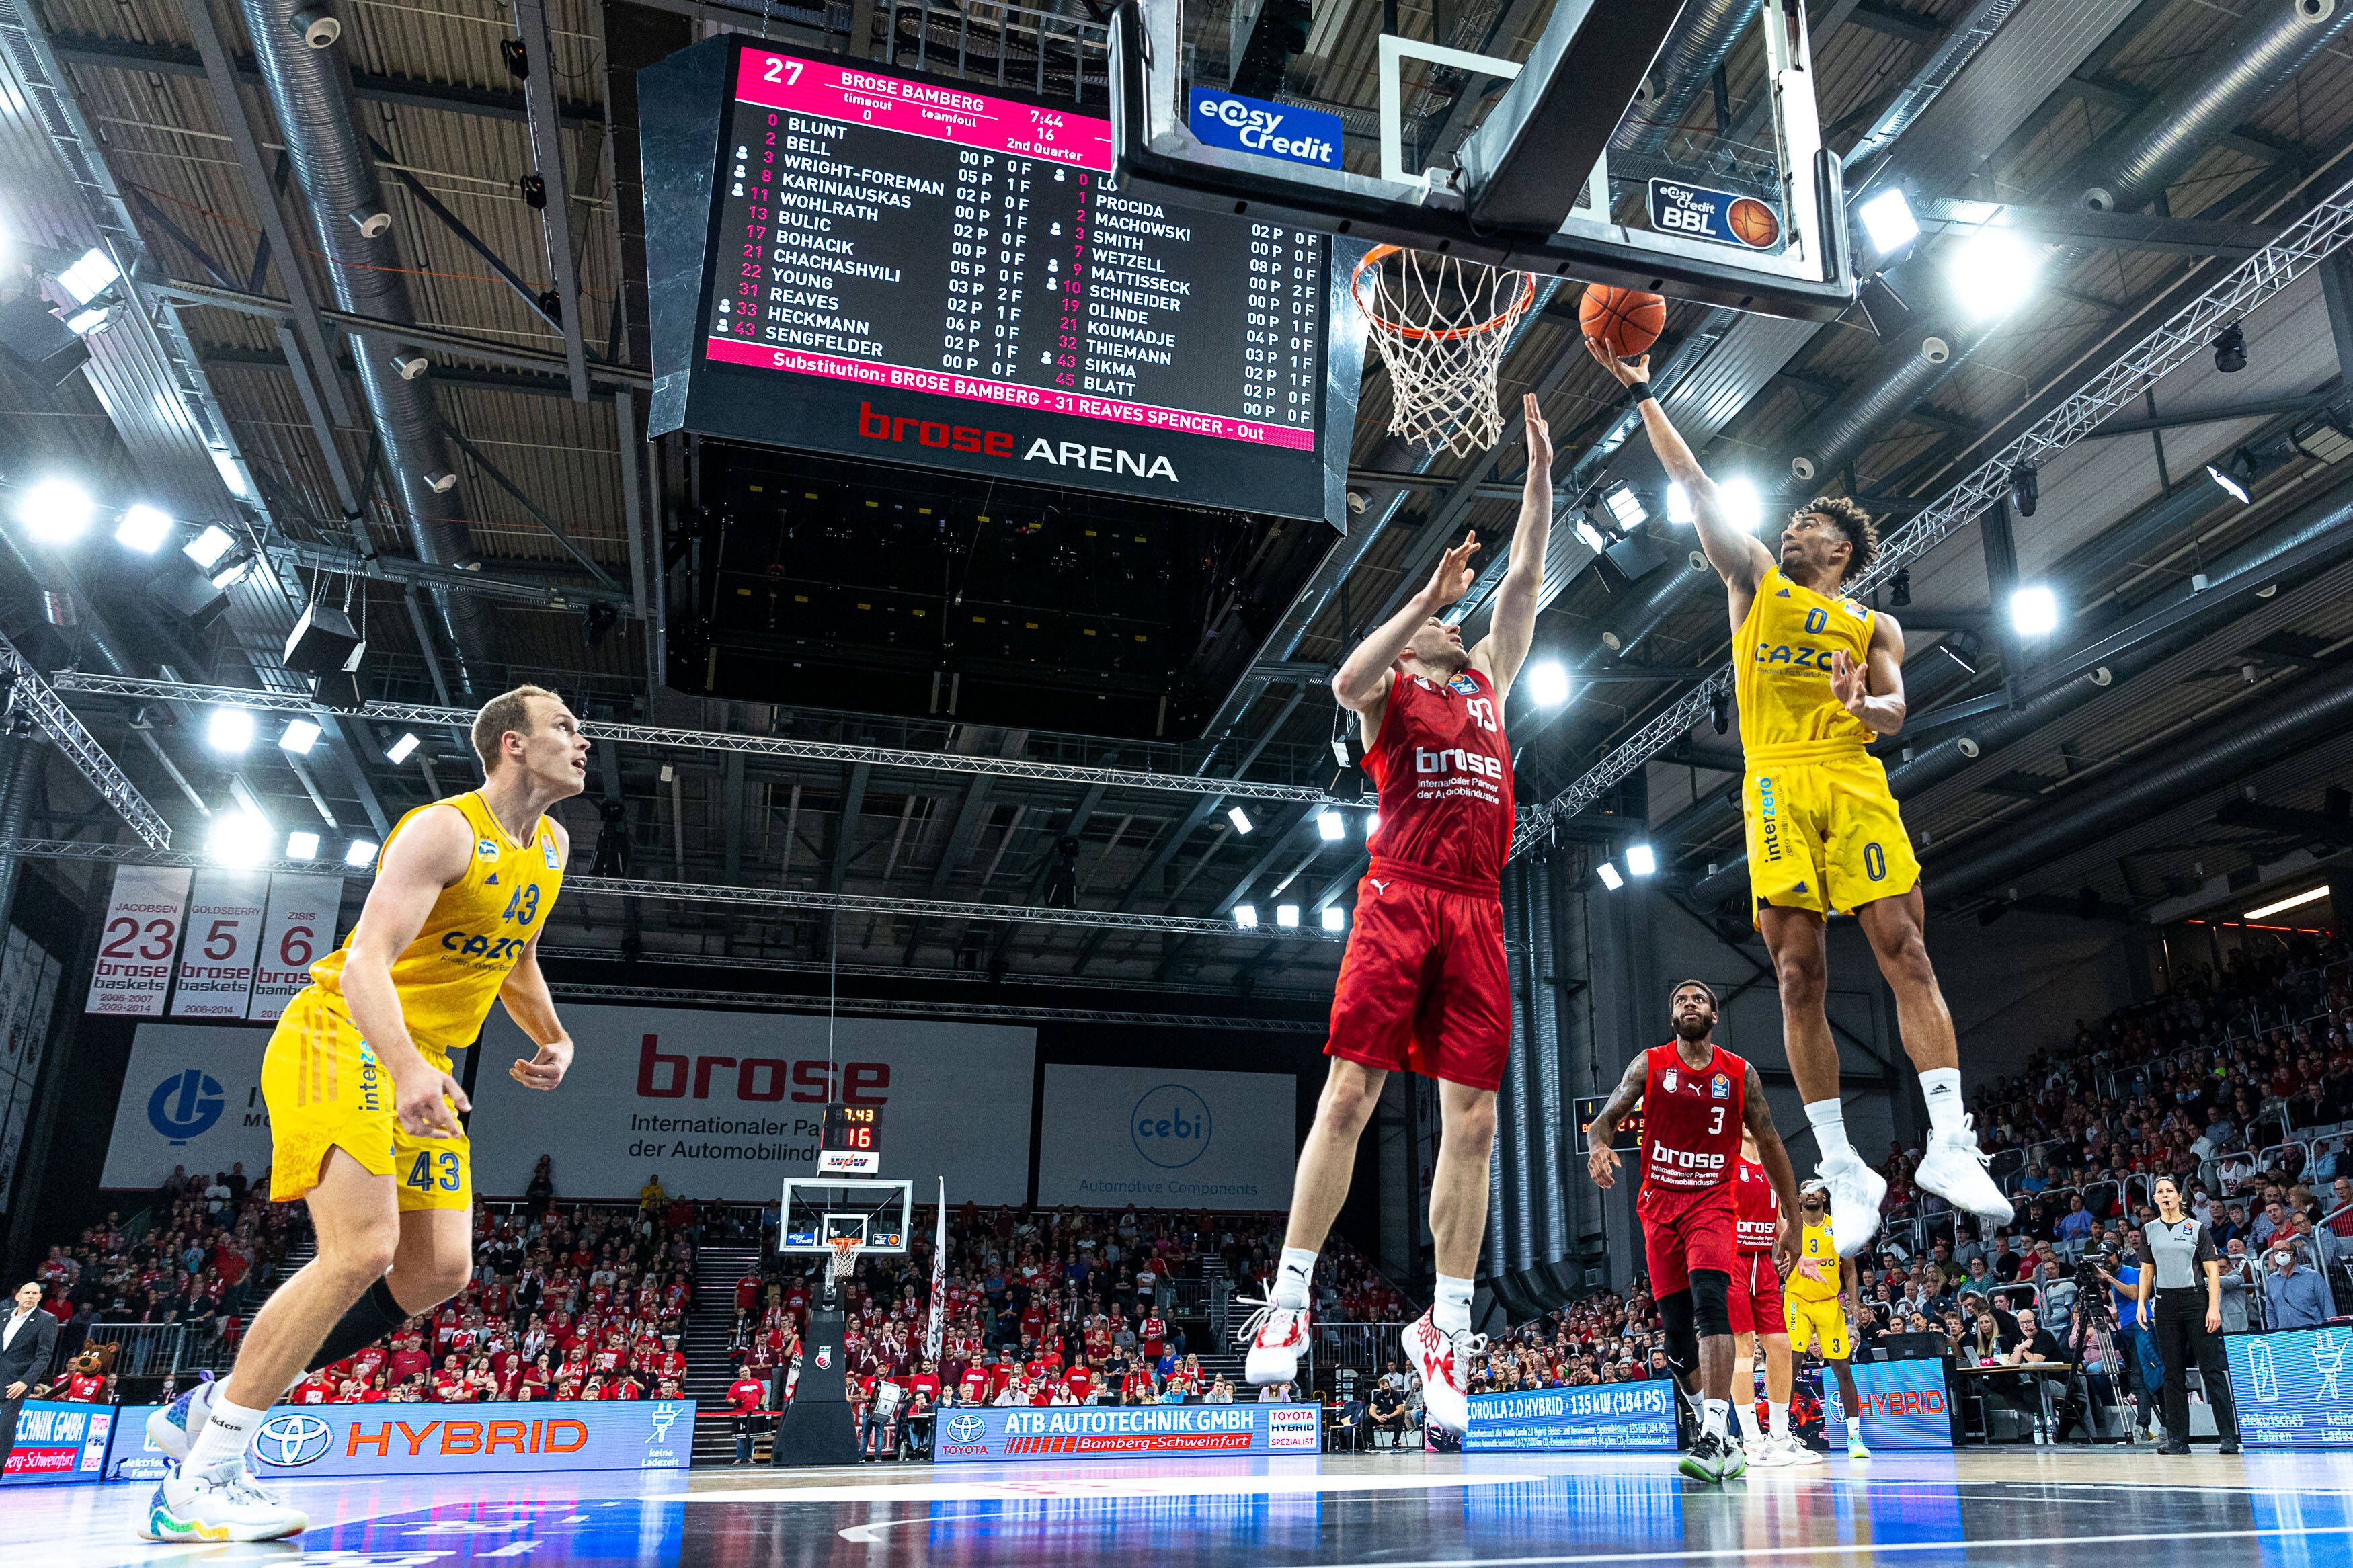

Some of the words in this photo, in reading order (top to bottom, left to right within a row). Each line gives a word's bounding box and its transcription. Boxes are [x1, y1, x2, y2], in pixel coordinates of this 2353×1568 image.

[763, 57, 804, 86] 27
[841, 71, 898, 95] BROSE
[902, 84, 984, 112] BAMBERG
[844, 92, 893, 111] timeout
[767, 113, 779, 127] 0
[788, 116, 848, 140] BLUNT
[863, 109, 872, 120] 0
[921, 108, 977, 128] teamfoul
[1030, 110, 1064, 128] 7:44
[765, 131, 776, 146] 2
[786, 135, 831, 157] BELL
[945, 125, 951, 137] 1
[1037, 127, 1055, 141] 16
[1239, 125, 1333, 163] Credit
[1006, 137, 1031, 151] 2nd
[1033, 142, 1084, 161] Quarter
[763, 150, 774, 164] 3
[784, 153, 945, 196] WRIGHT-FOREMAN
[1078, 173, 1088, 186] 0
[1097, 176, 1117, 192] LO
[761, 169, 772, 183] 8
[782, 172, 912, 208] KARINIAUSKAS
[750, 186, 768, 202] 11
[780, 191, 879, 222] WOHLRATH
[1078, 191, 1086, 204] 1
[1096, 194, 1164, 219] PROCIDA
[1677, 198, 1715, 214] Credit
[749, 205, 768, 221] 13
[778, 210, 832, 232] BULIC
[1076, 209, 1086, 222] 2
[1095, 212, 1191, 242] MACHOWSKI
[1662, 206, 1716, 235] BBL
[747, 224, 766, 239] 17
[776, 229, 854, 255] BOHACIK
[1075, 226, 1084, 240] 3
[1092, 230, 1144, 251] SMITH
[743, 243, 762, 259] 21
[774, 249, 901, 282] CHACHASHVILI
[1074, 244, 1084, 257] 7
[1092, 247, 1166, 274] WETZELL
[742, 263, 762, 279] 22
[772, 267, 833, 290] YOUNG
[1073, 263, 1082, 276] 9
[1091, 265, 1191, 296] MATTISSECK
[738, 282, 758, 297] 31
[770, 286, 839, 311] REAVES
[1063, 280, 1082, 294] 10
[1089, 284, 1181, 312] SCHNEIDER
[736, 300, 758, 317] 33
[768, 306, 869, 335] HECKMANN
[1062, 298, 1080, 313] 19
[1088, 302, 1148, 325] OLINDE
[733, 321, 756, 337] 43
[765, 325, 883, 357] SENGFELDER
[1059, 316, 1077, 331] 21
[1088, 321, 1176, 347] KOUMADJE
[1059, 335, 1077, 350] 32
[1086, 339, 1172, 366] THIEMANN
[1056, 353, 1076, 368] 43
[1084, 358, 1137, 378] SIKMA
[772, 352, 885, 381] Substitution:
[890, 370, 950, 392] BROSE
[954, 380, 1039, 405] BAMBERG
[1055, 395, 1073, 411] 31
[1078, 399, 1144, 421] REAVES
[1146, 410, 1222, 434] SPENCER
[1238, 424, 1264, 440] Out
[1055, 372, 1075, 386] 45
[1084, 376, 1136, 397] BLATT
[858, 401, 1014, 458] brose
[1023, 438, 1179, 482] ARENA
[1804, 608, 1827, 634] 0
[1755, 643, 1845, 675] CAZO
[1466, 698, 1497, 732] 43
[1416, 746, 1502, 780] brose
[1417, 790, 1433, 799] der
[1759, 778, 1781, 862] interzero
[1864, 842, 1886, 882] 0
[115, 903, 177, 913] JACOBSEN
[192, 905, 262, 915] GOLDSBERRY
[288, 911, 316, 921] ZISIS
[502, 884, 539, 925] 43
[101, 917, 175, 960] 23
[204, 920, 239, 960] 5
[280, 925, 314, 966] 6
[442, 931, 526, 960] CAZO
[97, 959, 168, 977] brose
[182, 962, 250, 979] brose
[258, 967, 313, 984] bros
[94, 977, 165, 991] baskets
[178, 979, 247, 992] baskets
[255, 984, 301, 995] bamb
[358, 1040, 380, 1111] interze
[636, 1034, 891, 1105] brose
[631, 1114, 787, 1136] Internationaler
[794, 1119, 820, 1137] Pa
[1138, 1107, 1201, 1139] cebi
[1708, 1106, 1726, 1134] 3
[629, 1140, 666, 1157] der
[671, 1141, 820, 1161] Automobilind
[849, 1128, 871, 1147] 16
[1652, 1139, 1724, 1169] brose
[407, 1151, 460, 1191] 43
[1079, 1180, 1163, 1194] Automotive
[1168, 1181, 1258, 1196] Components
[1810, 1238, 1818, 1253] 3
[1833, 1338, 1840, 1353] 3
[1271, 1411, 1314, 1421] TOYOTA
[1467, 1399, 1507, 1420] COROLLA
[1509, 1398, 1523, 1419] 2.0
[1524, 1396, 1563, 1417] HYBRID
[1571, 1394, 1591, 1415] 135
[1593, 1392, 1611, 1414] kW
[1613, 1391, 1642, 1417] (184
[1644, 1389, 1667, 1416] PS)
[1858, 1390, 1944, 1416] HYBRID
[53, 1411, 87, 1442] GMBH
[1004, 1412, 1047, 1434] ATB
[1049, 1410, 1193, 1433] AUTOTECHNIK
[1197, 1410, 1254, 1431] GMBH
[1271, 1423, 1314, 1432] HYBRID
[346, 1419, 588, 1457] HYBRID
[942, 1446, 988, 1454] TOYOTA
[1080, 1436, 1248, 1450] Bamberg-Schweinfurt
[641, 1458, 680, 1467] Ladezeit
[649, 1448, 674, 1458] keine
